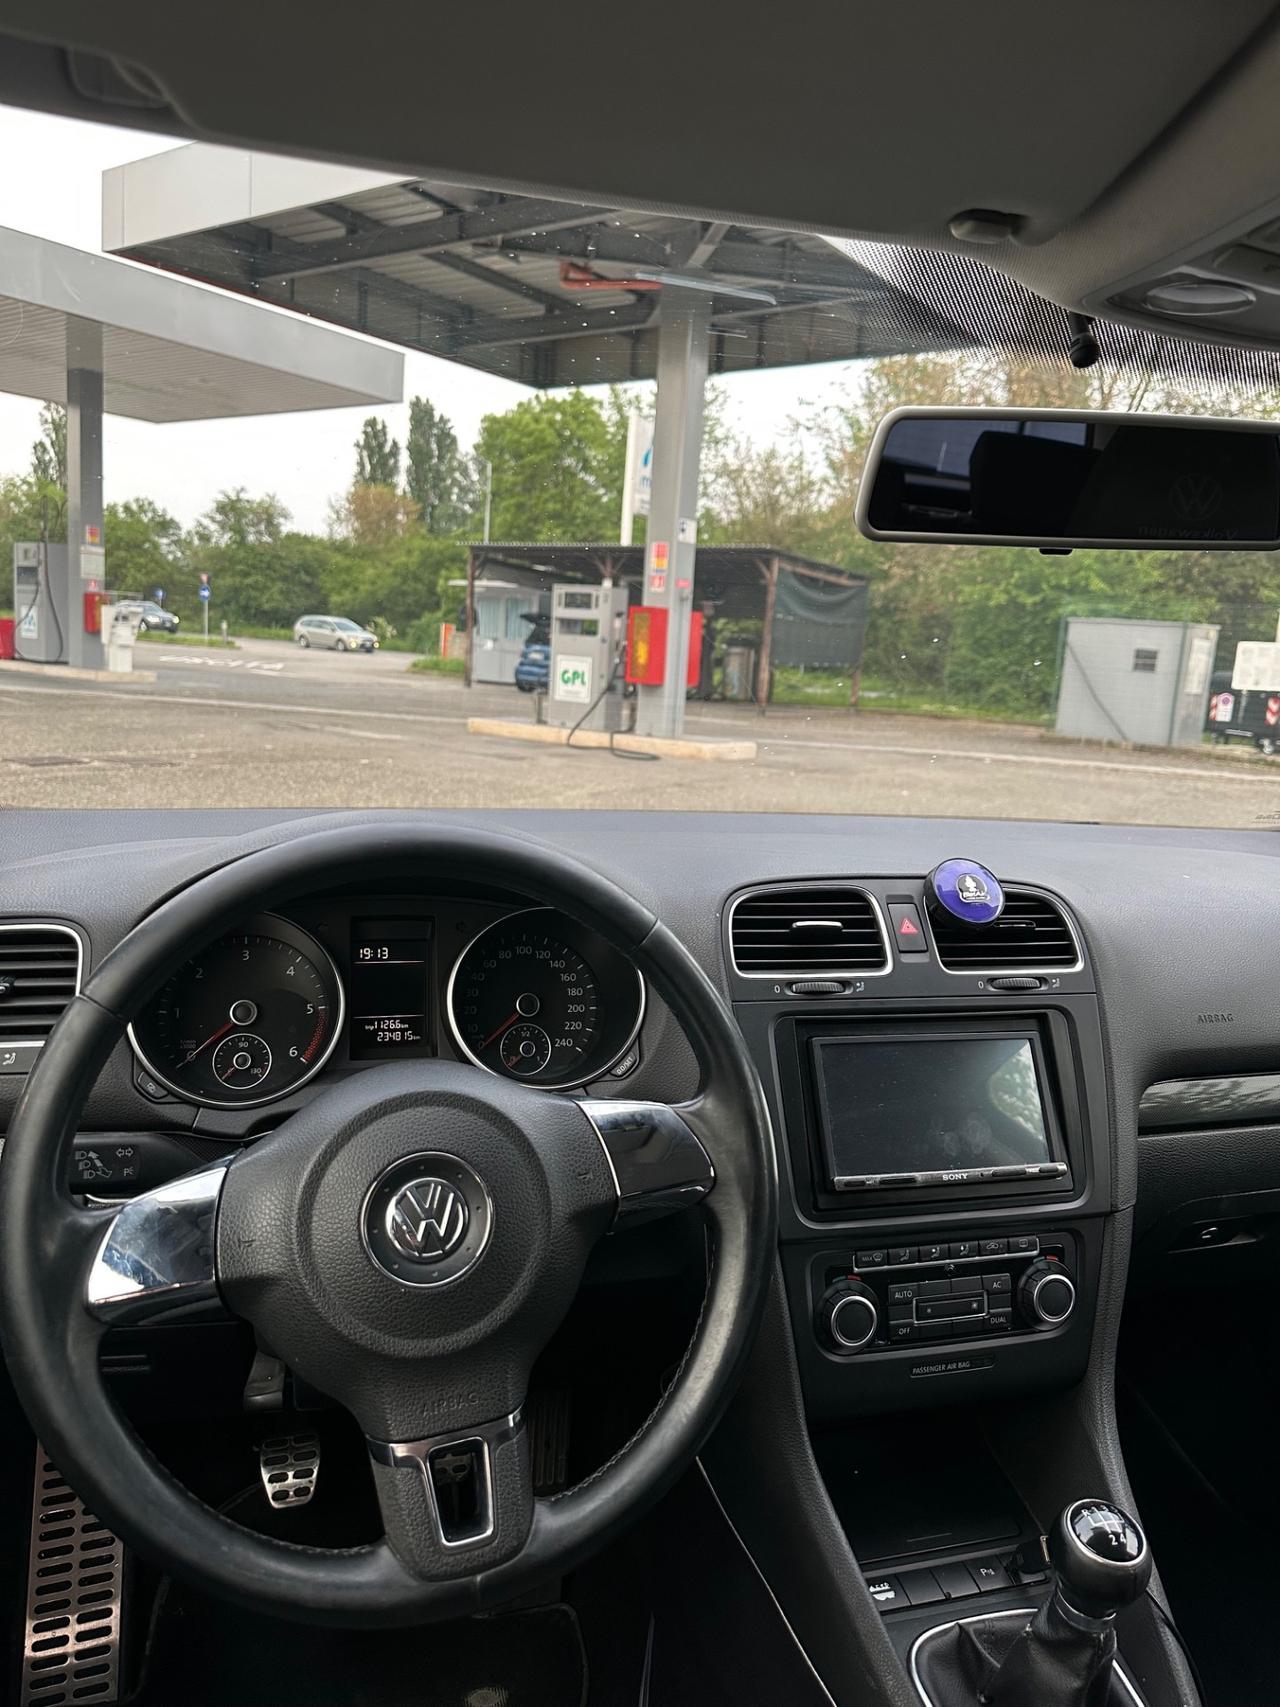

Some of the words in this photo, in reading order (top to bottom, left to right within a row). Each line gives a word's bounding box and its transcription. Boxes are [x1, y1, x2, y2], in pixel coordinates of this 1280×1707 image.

[560, 669, 587, 686] GPL
[242, 950, 250, 960] 3
[359, 947, 389, 959] 19:13
[498, 950, 512, 960] 80
[515, 945, 533, 955] 100
[535, 950, 551, 959] 120
[483, 960, 497, 968] 60
[549, 960, 566, 969] 140
[195, 968, 204, 979] 2
[286, 966, 295, 976] 4
[559, 972, 577, 982] 160
[567, 987, 584, 997] 180
[306, 1004, 314, 1014] 5
[567, 1004, 586, 1013] 200
[1197, 1013, 1234, 1023] AIRBAG
[564, 1021, 583, 1031] 220
[554, 1038, 573, 1047] 240
[289, 1046, 298, 1057] 6
[942, 1172, 969, 1181] SONY
[992, 1280, 1002, 1289] AC
[894, 1289, 913, 1299] AUTO
[990, 1315, 1007, 1325] DUAL
[898, 1326, 911, 1335] OFF
[912, 1364, 946, 1374] PASSENGER
[946, 1362, 957, 1371] AIR
[421, 1391, 480, 1418] AIRBAG
[1108, 1534, 1118, 1545] 2
[1119, 1533, 1127, 1544] 4
